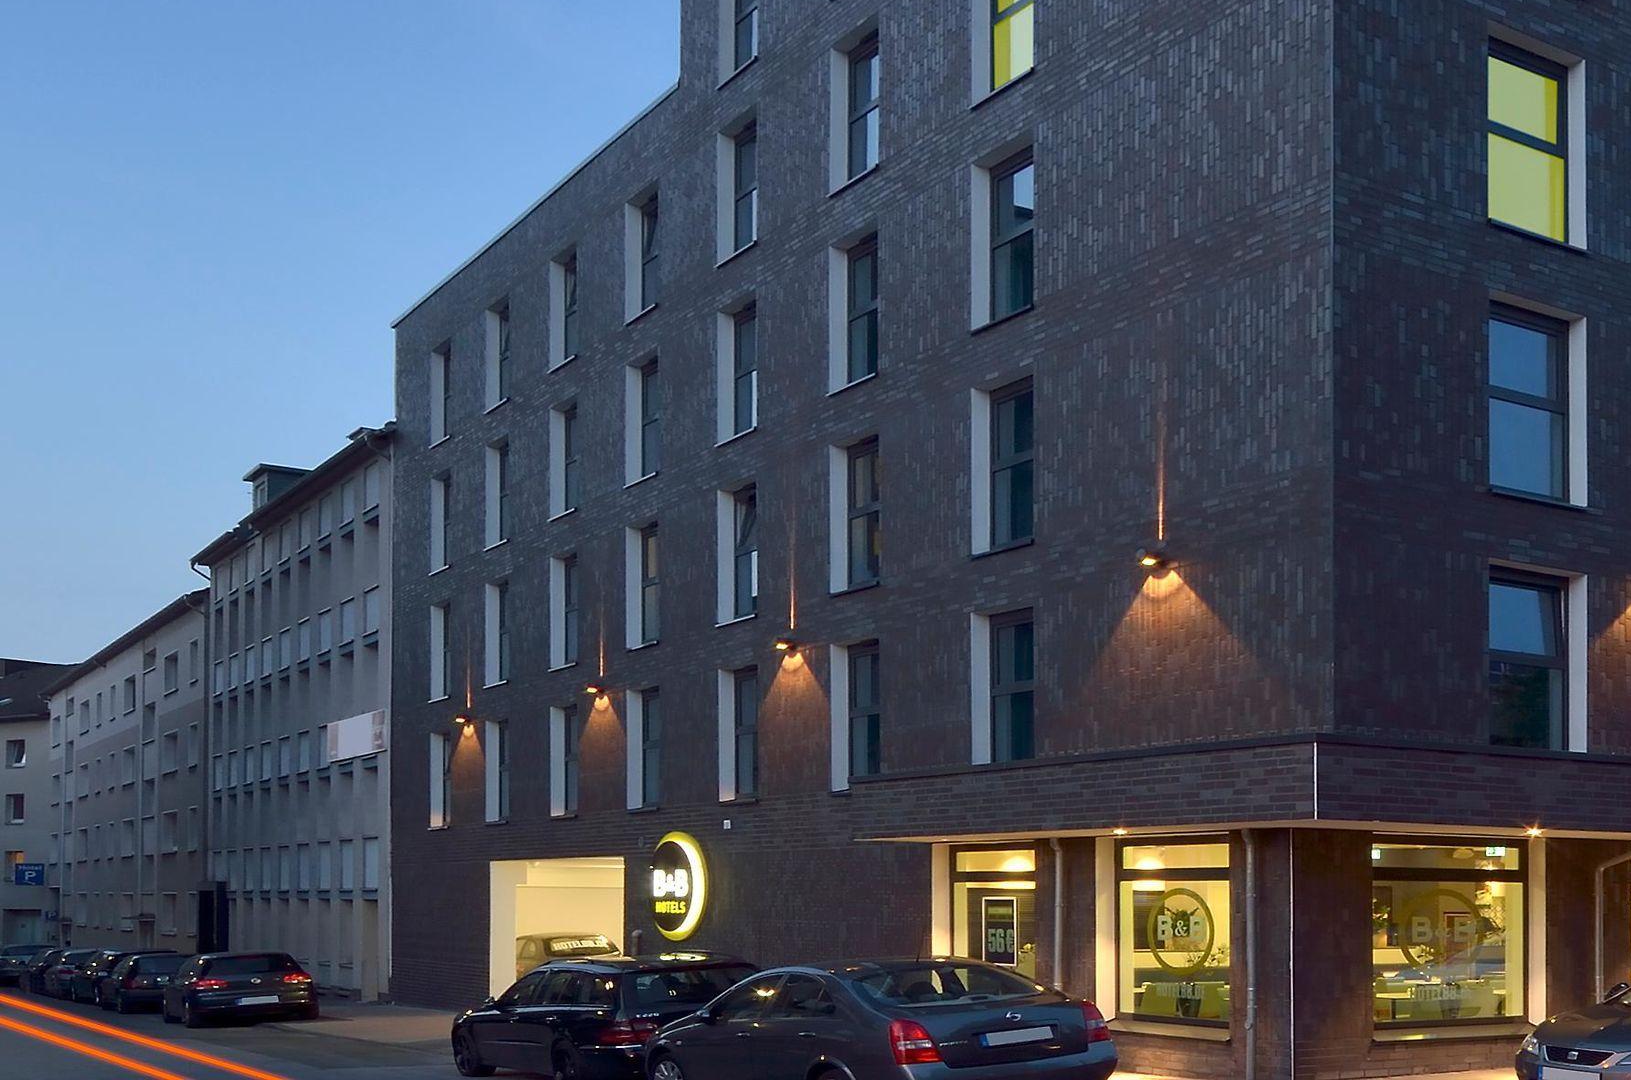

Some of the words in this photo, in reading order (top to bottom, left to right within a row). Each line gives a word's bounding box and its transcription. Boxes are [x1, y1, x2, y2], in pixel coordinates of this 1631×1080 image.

[652, 868, 689, 898] B&B
[655, 901, 686, 914] HOTELS
[987, 928, 1014, 953] 56€
[1157, 915, 1207, 941] B&B
[1411, 916, 1478, 943] B&B
